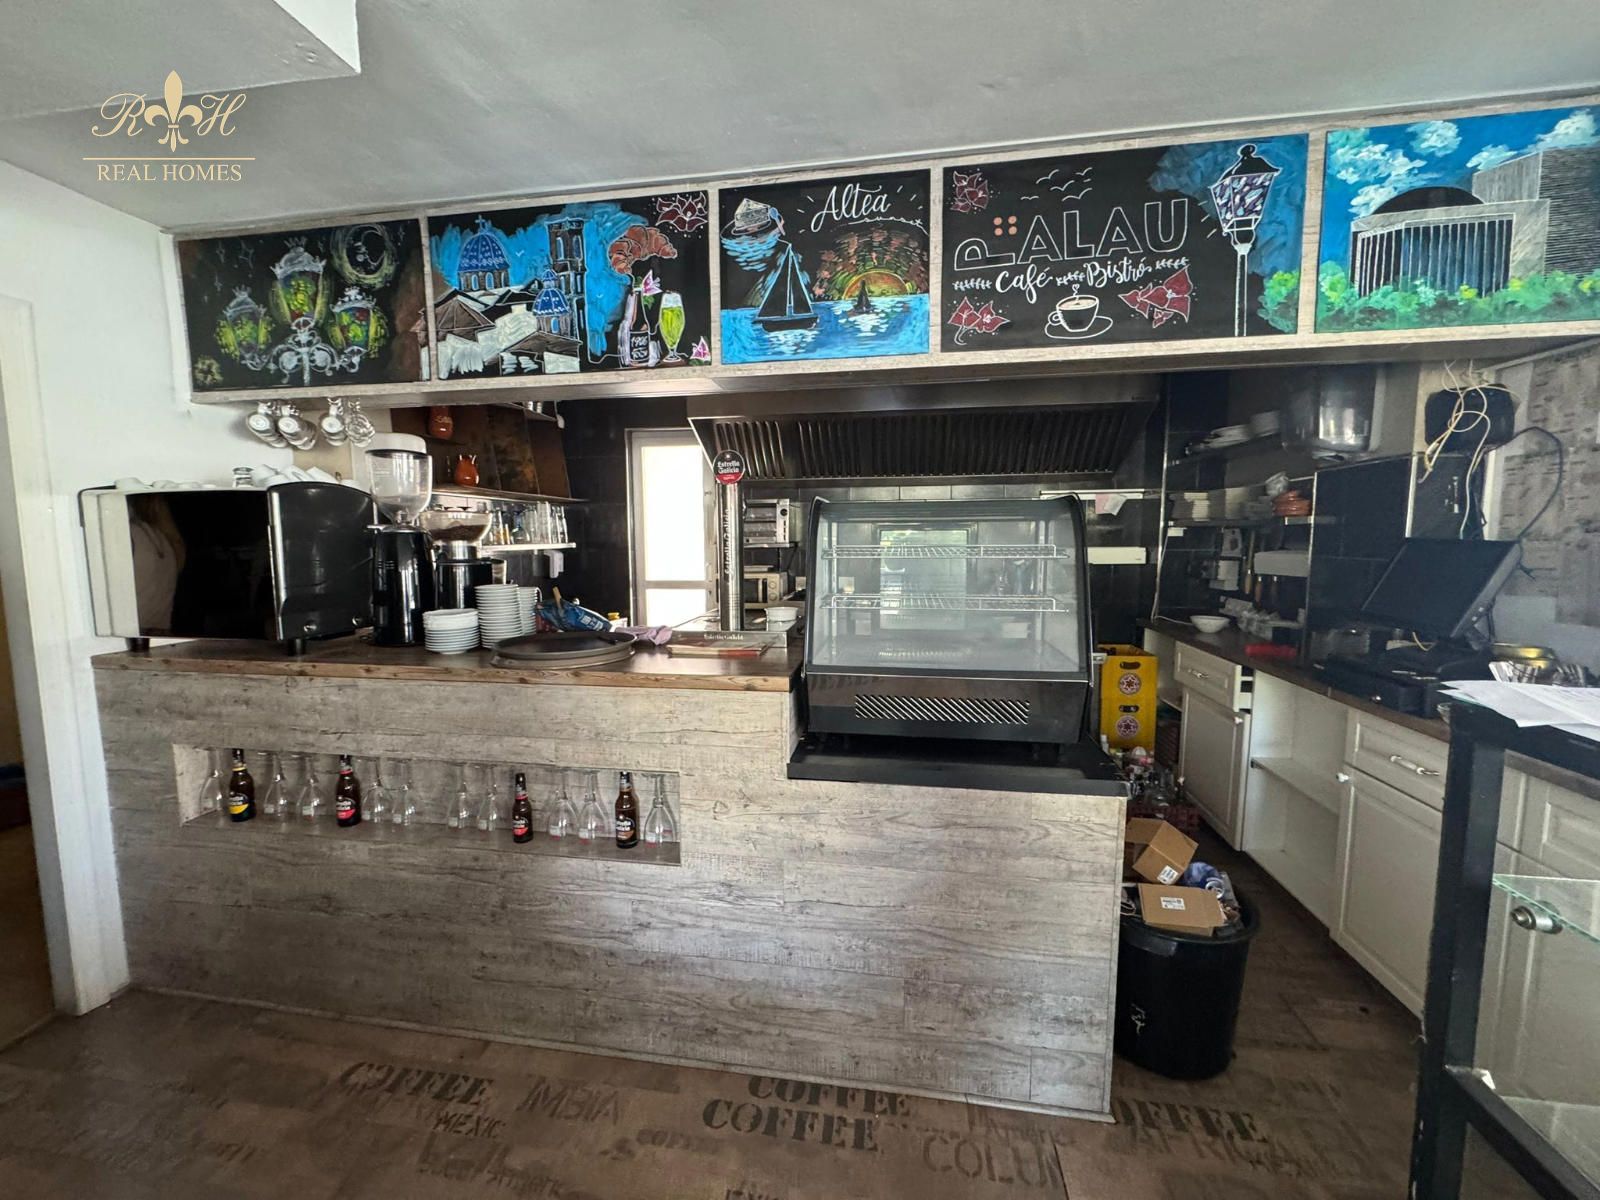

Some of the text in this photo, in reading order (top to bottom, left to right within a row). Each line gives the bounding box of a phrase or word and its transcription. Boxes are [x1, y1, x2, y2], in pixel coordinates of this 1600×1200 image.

[811, 182, 892, 233] Altea
[954, 198, 1189, 271] PALAU
[995, 256, 1153, 304] Café Bistró
[339, 1061, 494, 1106] COFFEE
[748, 1075, 913, 1118] COFFEE
[702, 1098, 879, 1152] COFFEE
